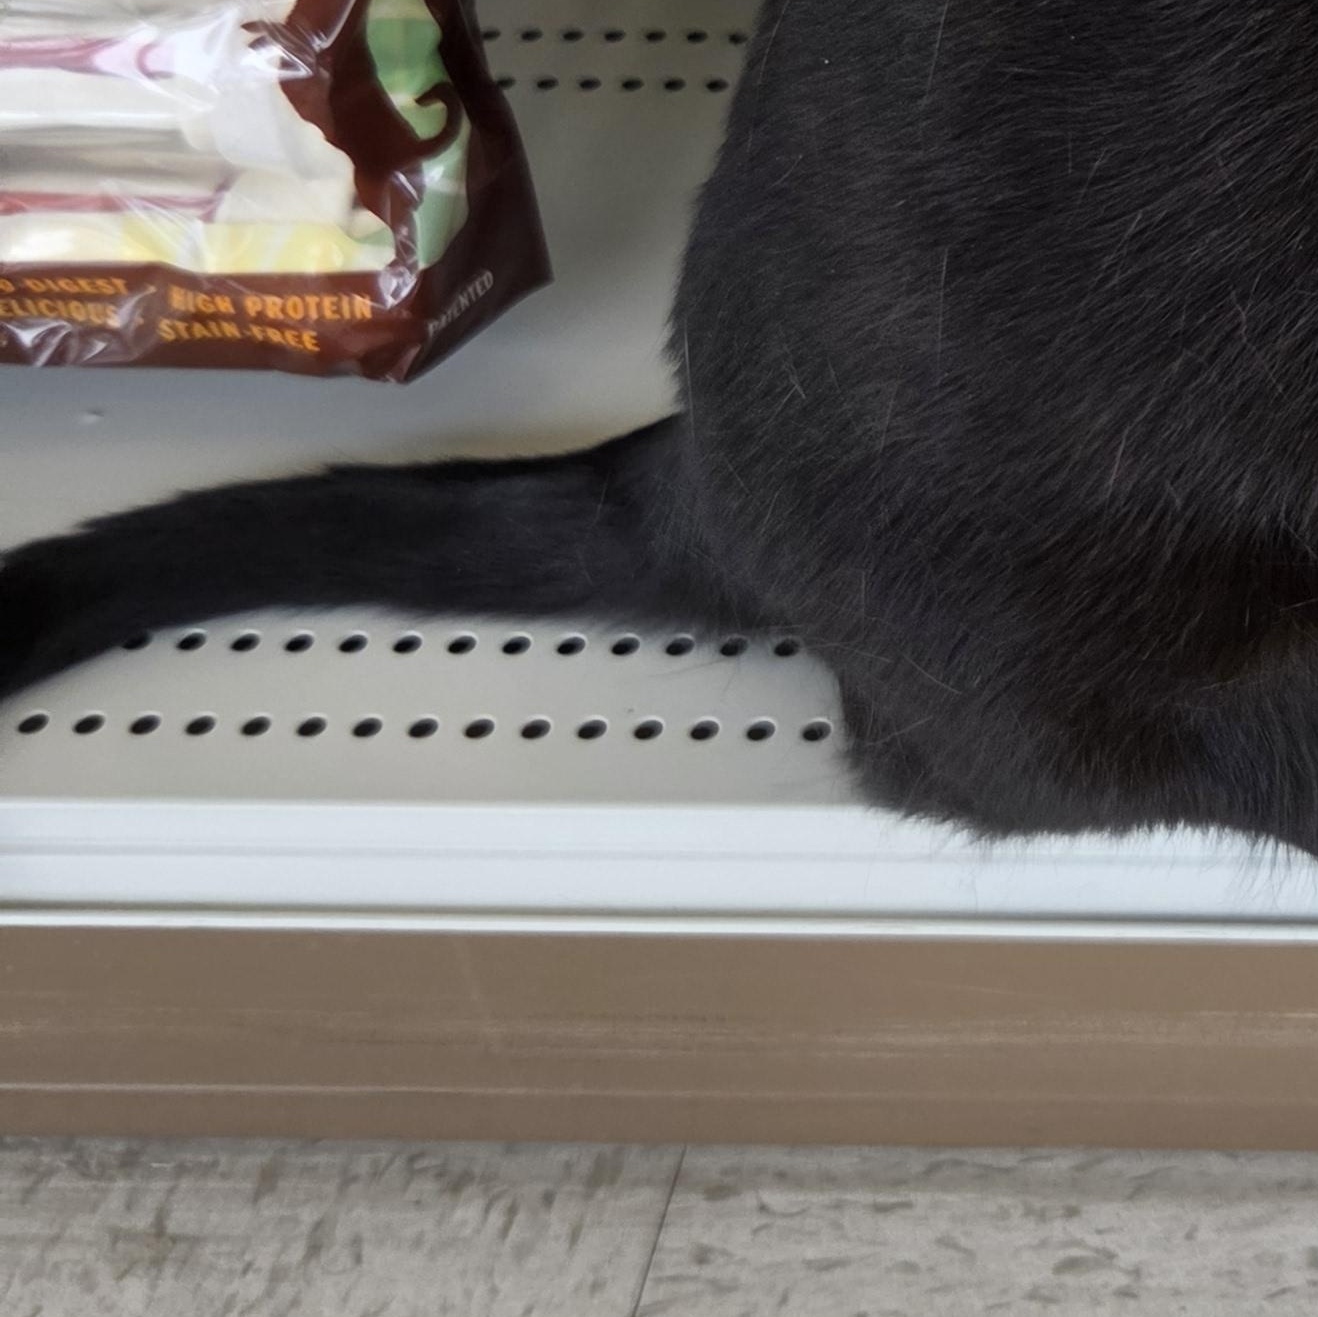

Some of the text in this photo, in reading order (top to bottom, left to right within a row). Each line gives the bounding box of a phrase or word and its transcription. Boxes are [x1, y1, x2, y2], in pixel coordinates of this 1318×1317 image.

[23, 277, 129, 295] DIGEST
[168, 285, 236, 315] HIGH
[244, 293, 373, 321] PROTEIN
[158, 317, 321, 352] STAIN-FREE
